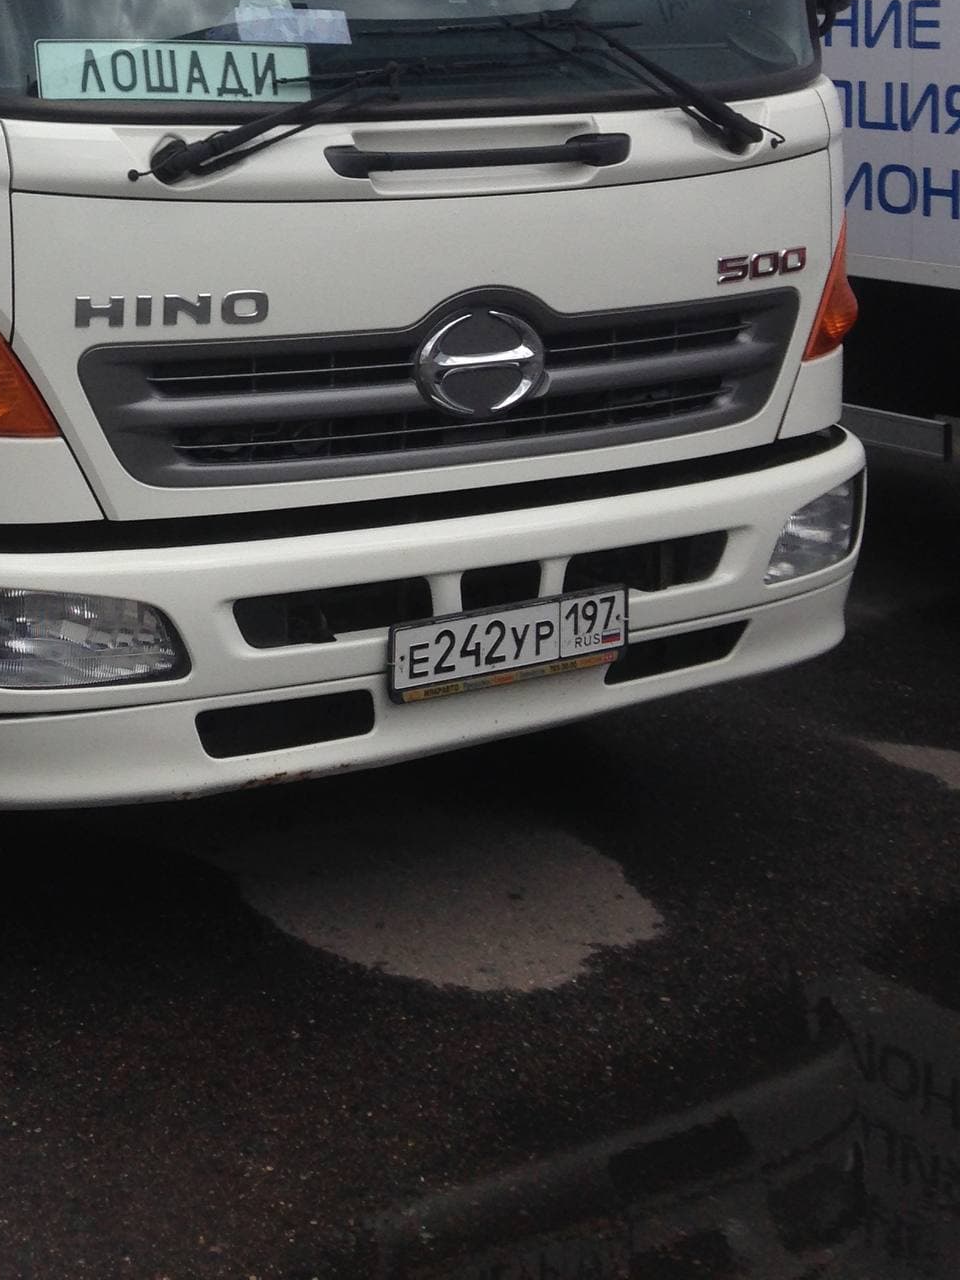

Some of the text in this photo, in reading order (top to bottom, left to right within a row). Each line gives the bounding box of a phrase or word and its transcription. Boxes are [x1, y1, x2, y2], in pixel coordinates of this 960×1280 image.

[80, 48, 279, 97] ЛОШАДИ
[717, 246, 807, 285] 500
[74, 289, 270, 328] HINO
[564, 595, 617, 636] 197
[574, 634, 601, 649] RUS
